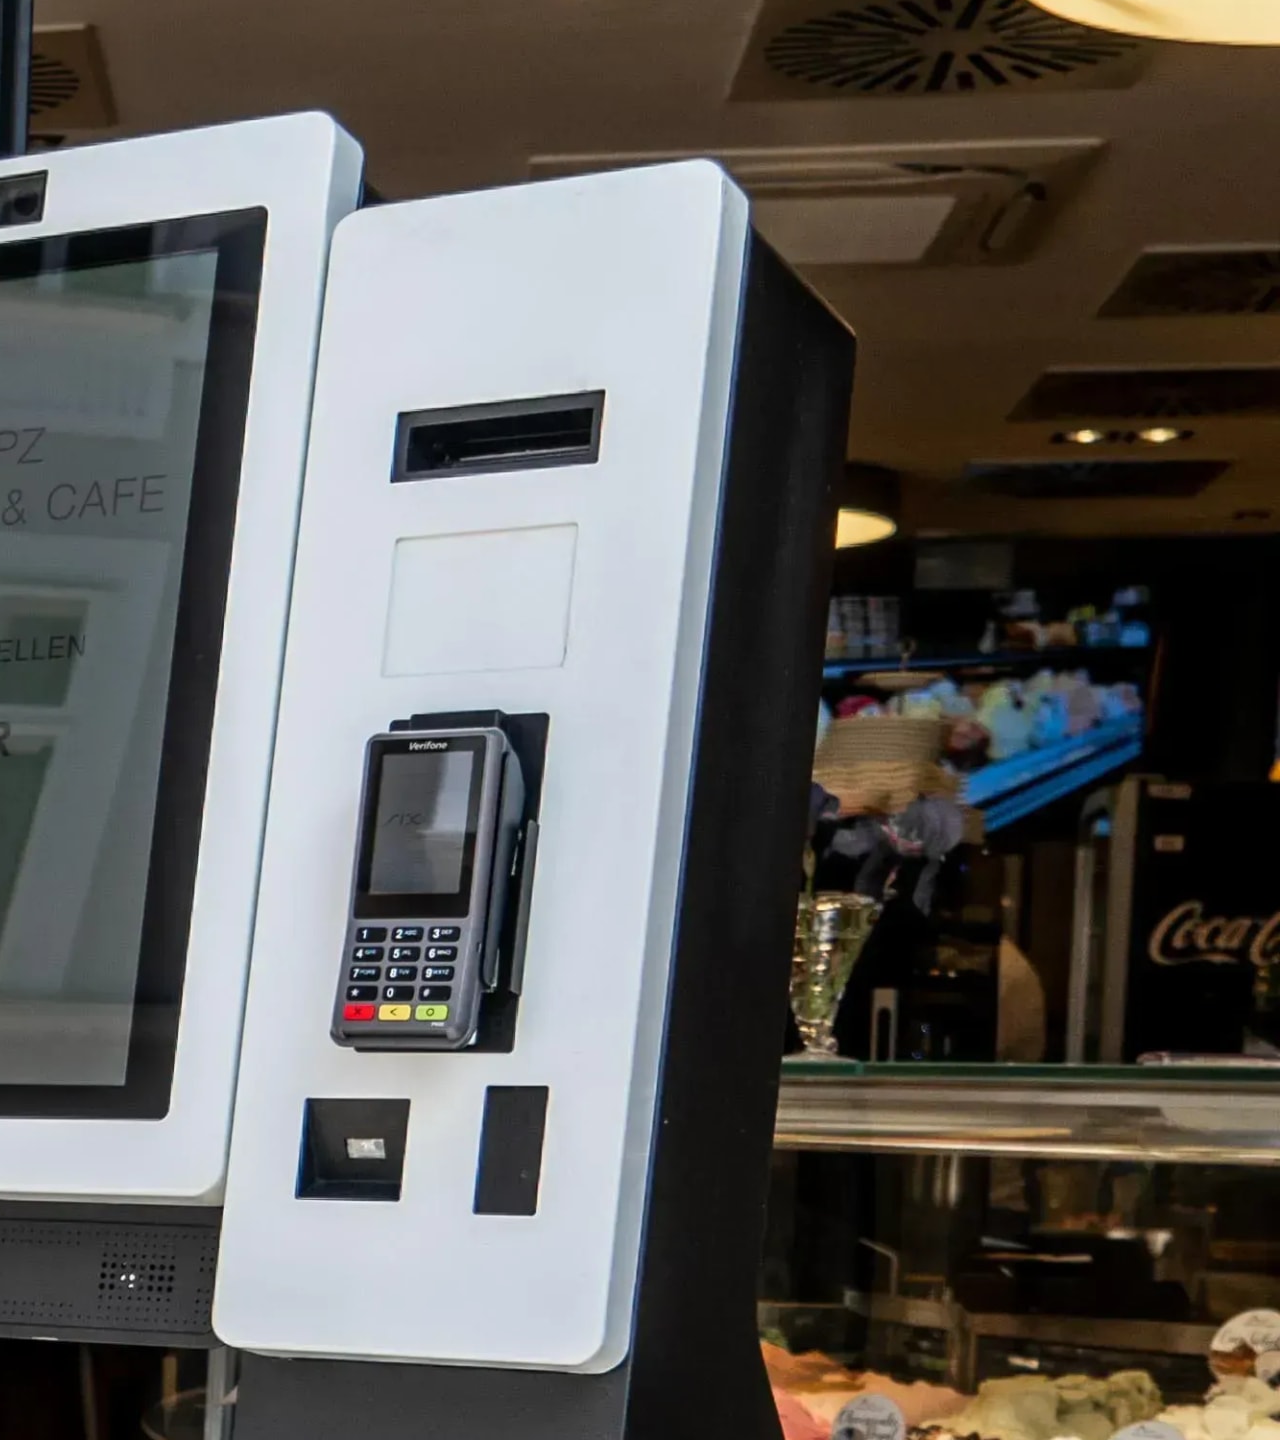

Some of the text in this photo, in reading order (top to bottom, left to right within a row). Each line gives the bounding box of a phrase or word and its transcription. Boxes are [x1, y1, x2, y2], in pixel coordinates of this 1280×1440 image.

[1, 488, 27, 526] &
[45, 474, 168, 521] CAFE
[408, 740, 448, 751] Verifone
